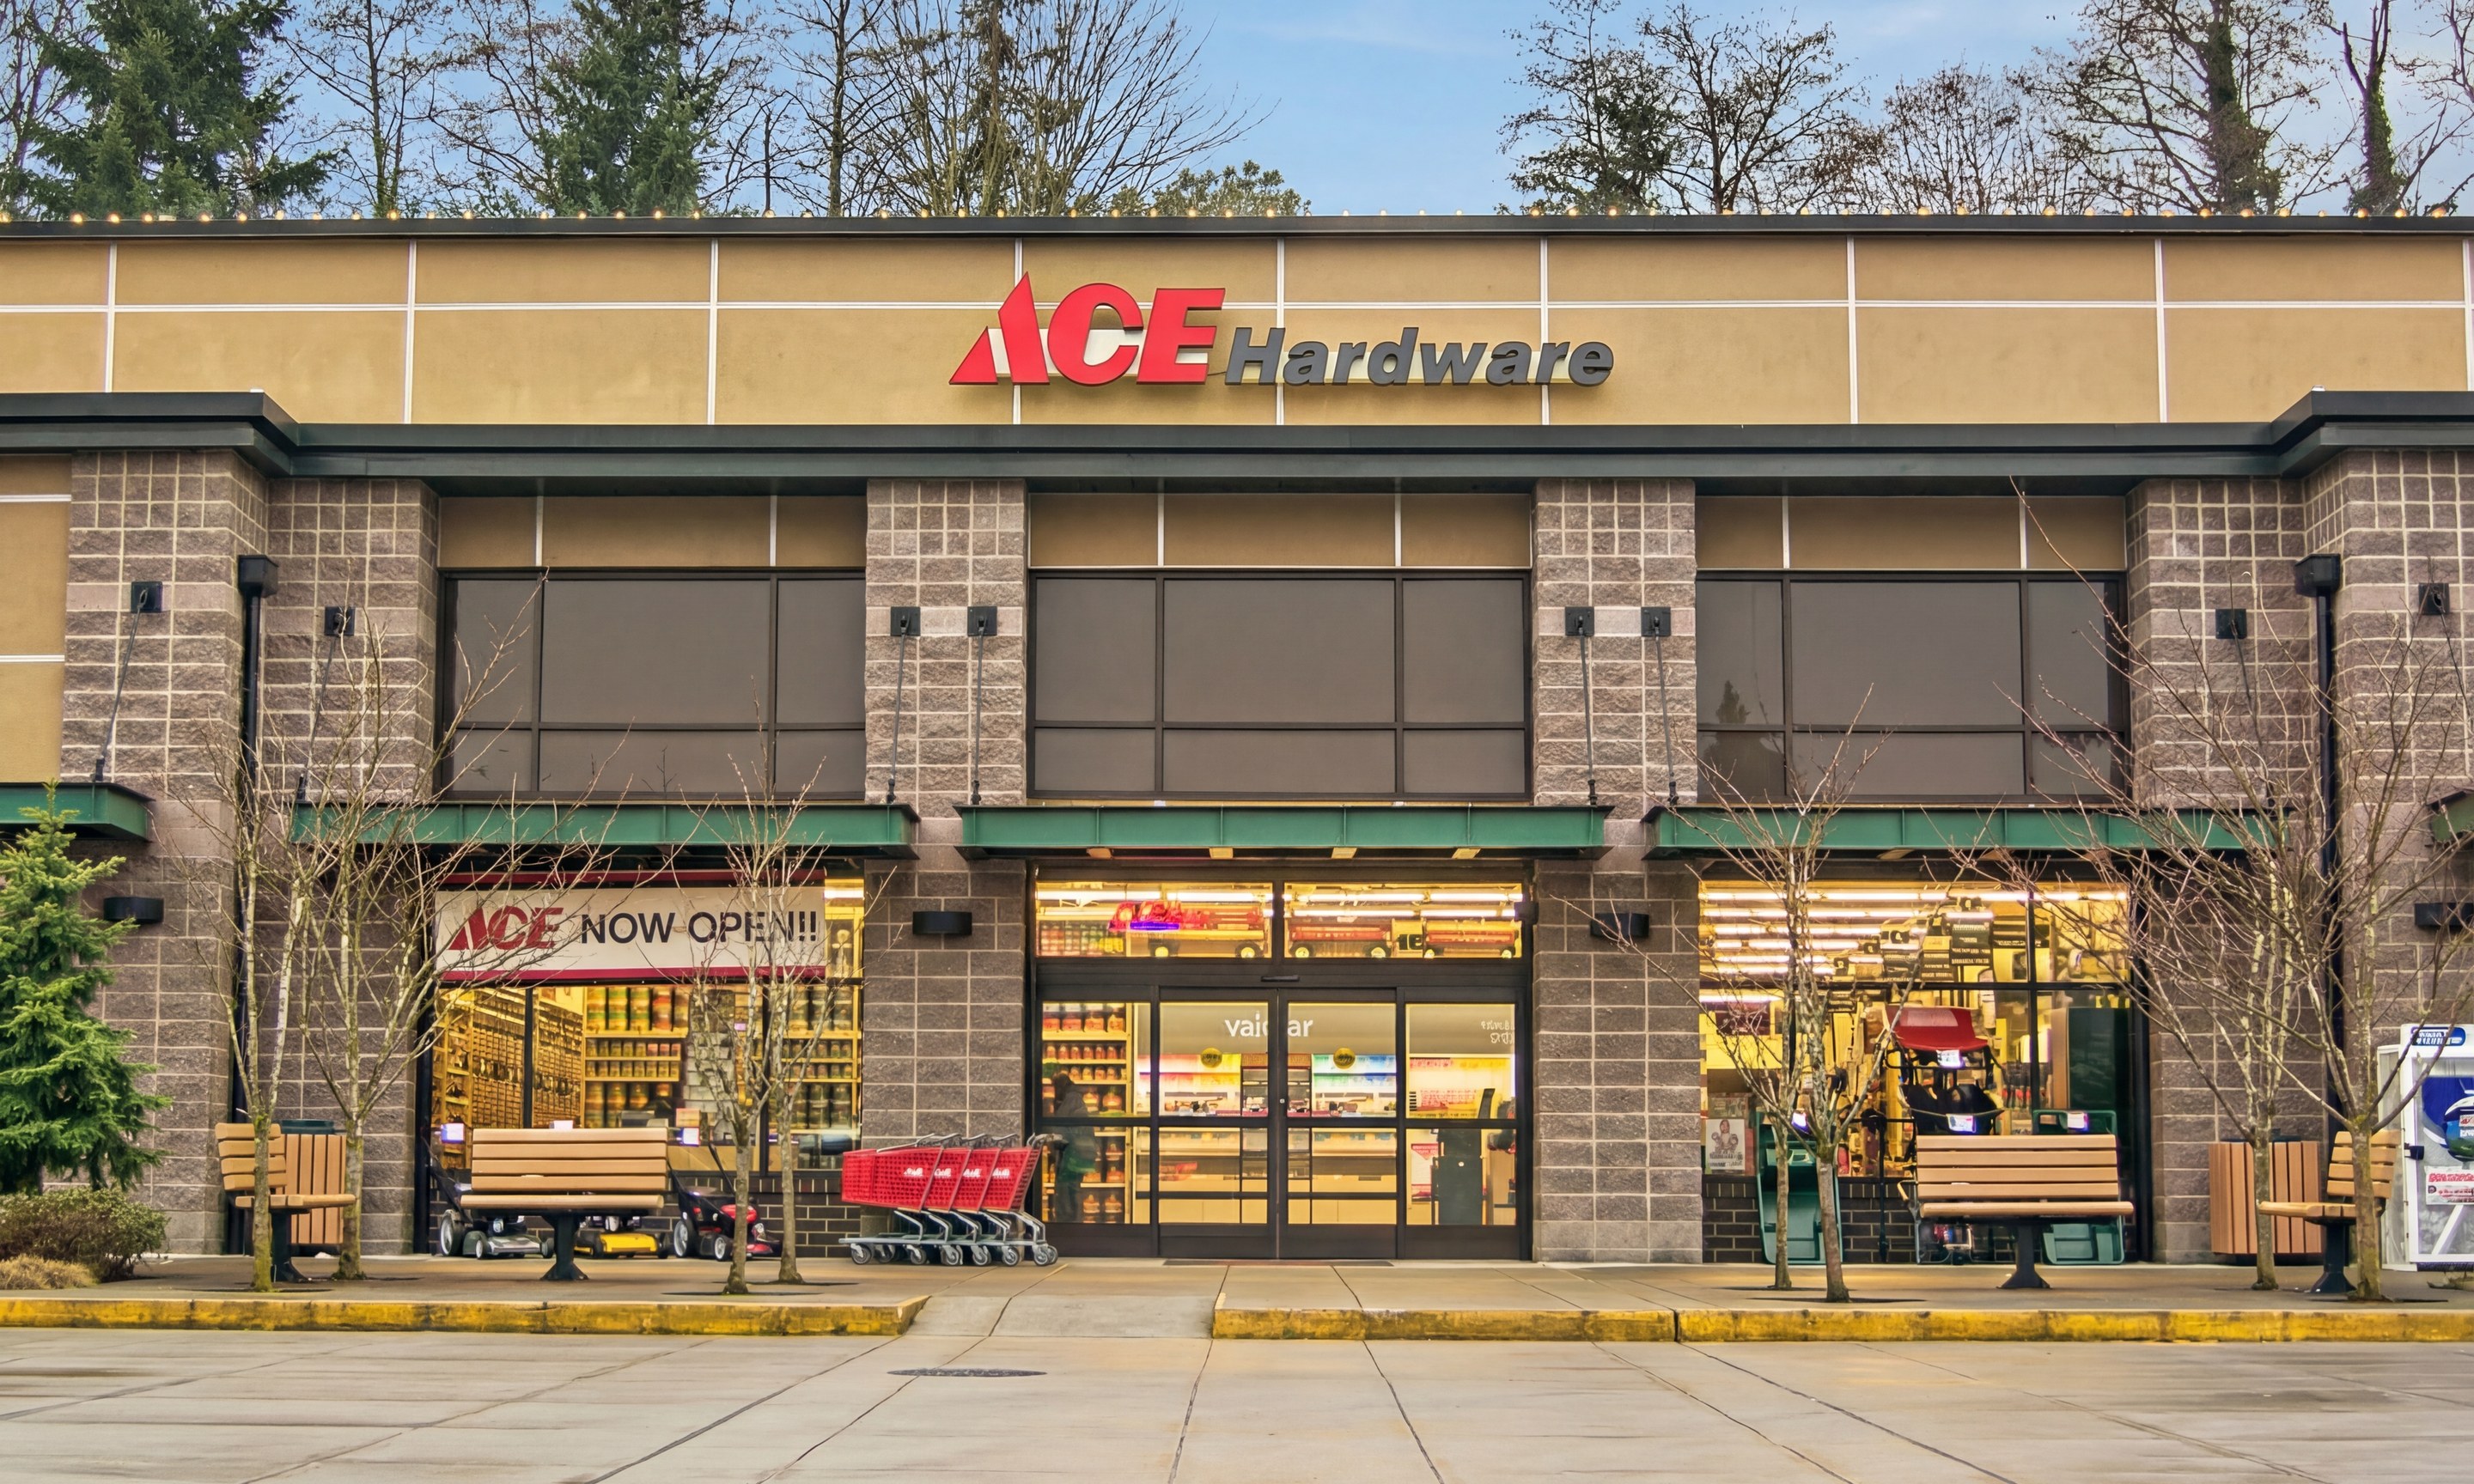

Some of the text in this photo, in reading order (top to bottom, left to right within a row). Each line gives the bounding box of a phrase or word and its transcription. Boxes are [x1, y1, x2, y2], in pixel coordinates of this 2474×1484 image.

[948, 271, 1614, 386] ACE Hardware
[448, 905, 817, 950] ACE NOW OPEN!!
